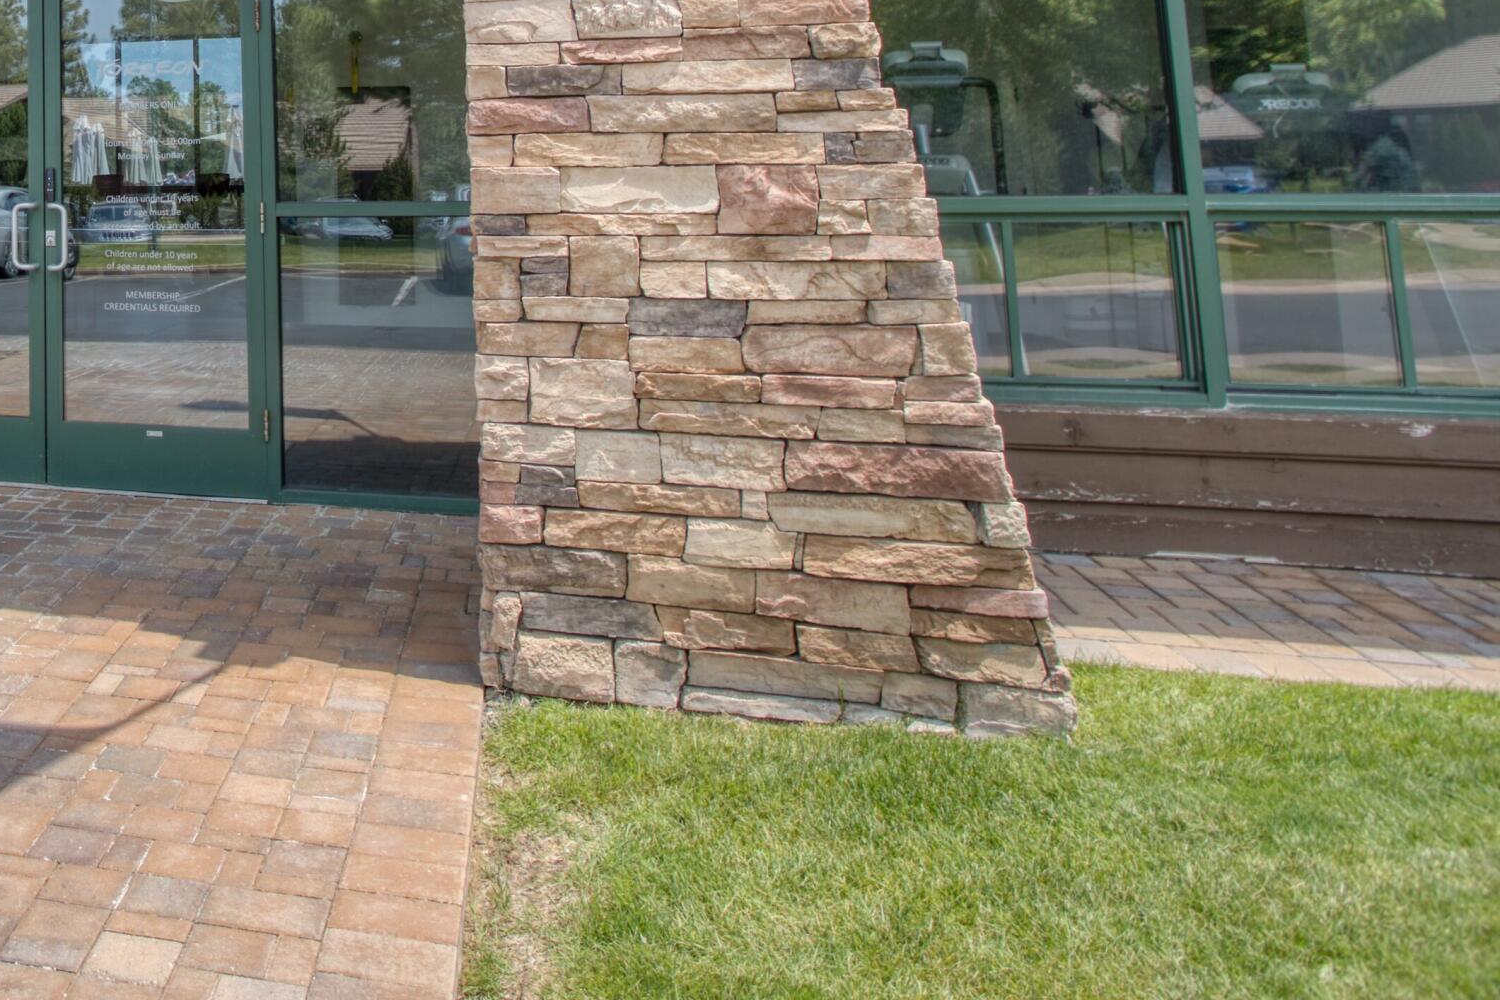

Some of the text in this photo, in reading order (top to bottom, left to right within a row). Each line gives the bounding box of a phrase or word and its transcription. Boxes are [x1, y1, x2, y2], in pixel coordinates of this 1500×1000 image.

[105, 194, 139, 203] Children
[140, 194, 163, 203] under
[178, 193, 199, 203] years
[123, 209, 132, 217] of
[133, 210, 148, 218] age
[149, 208, 169, 216] must
[156, 221, 167, 230] by
[179, 221, 203, 230] adult.
[104, 249, 198, 261] Children under 10 years
[106, 262, 115, 270] of
[116, 264, 131, 272] age
[146, 263, 161, 271] not
[162, 263, 197, 272] allowed.
[125, 290, 181, 300] MEMBERSHIP
[104, 302, 201, 313] CREDENTIALS REQUIRED
